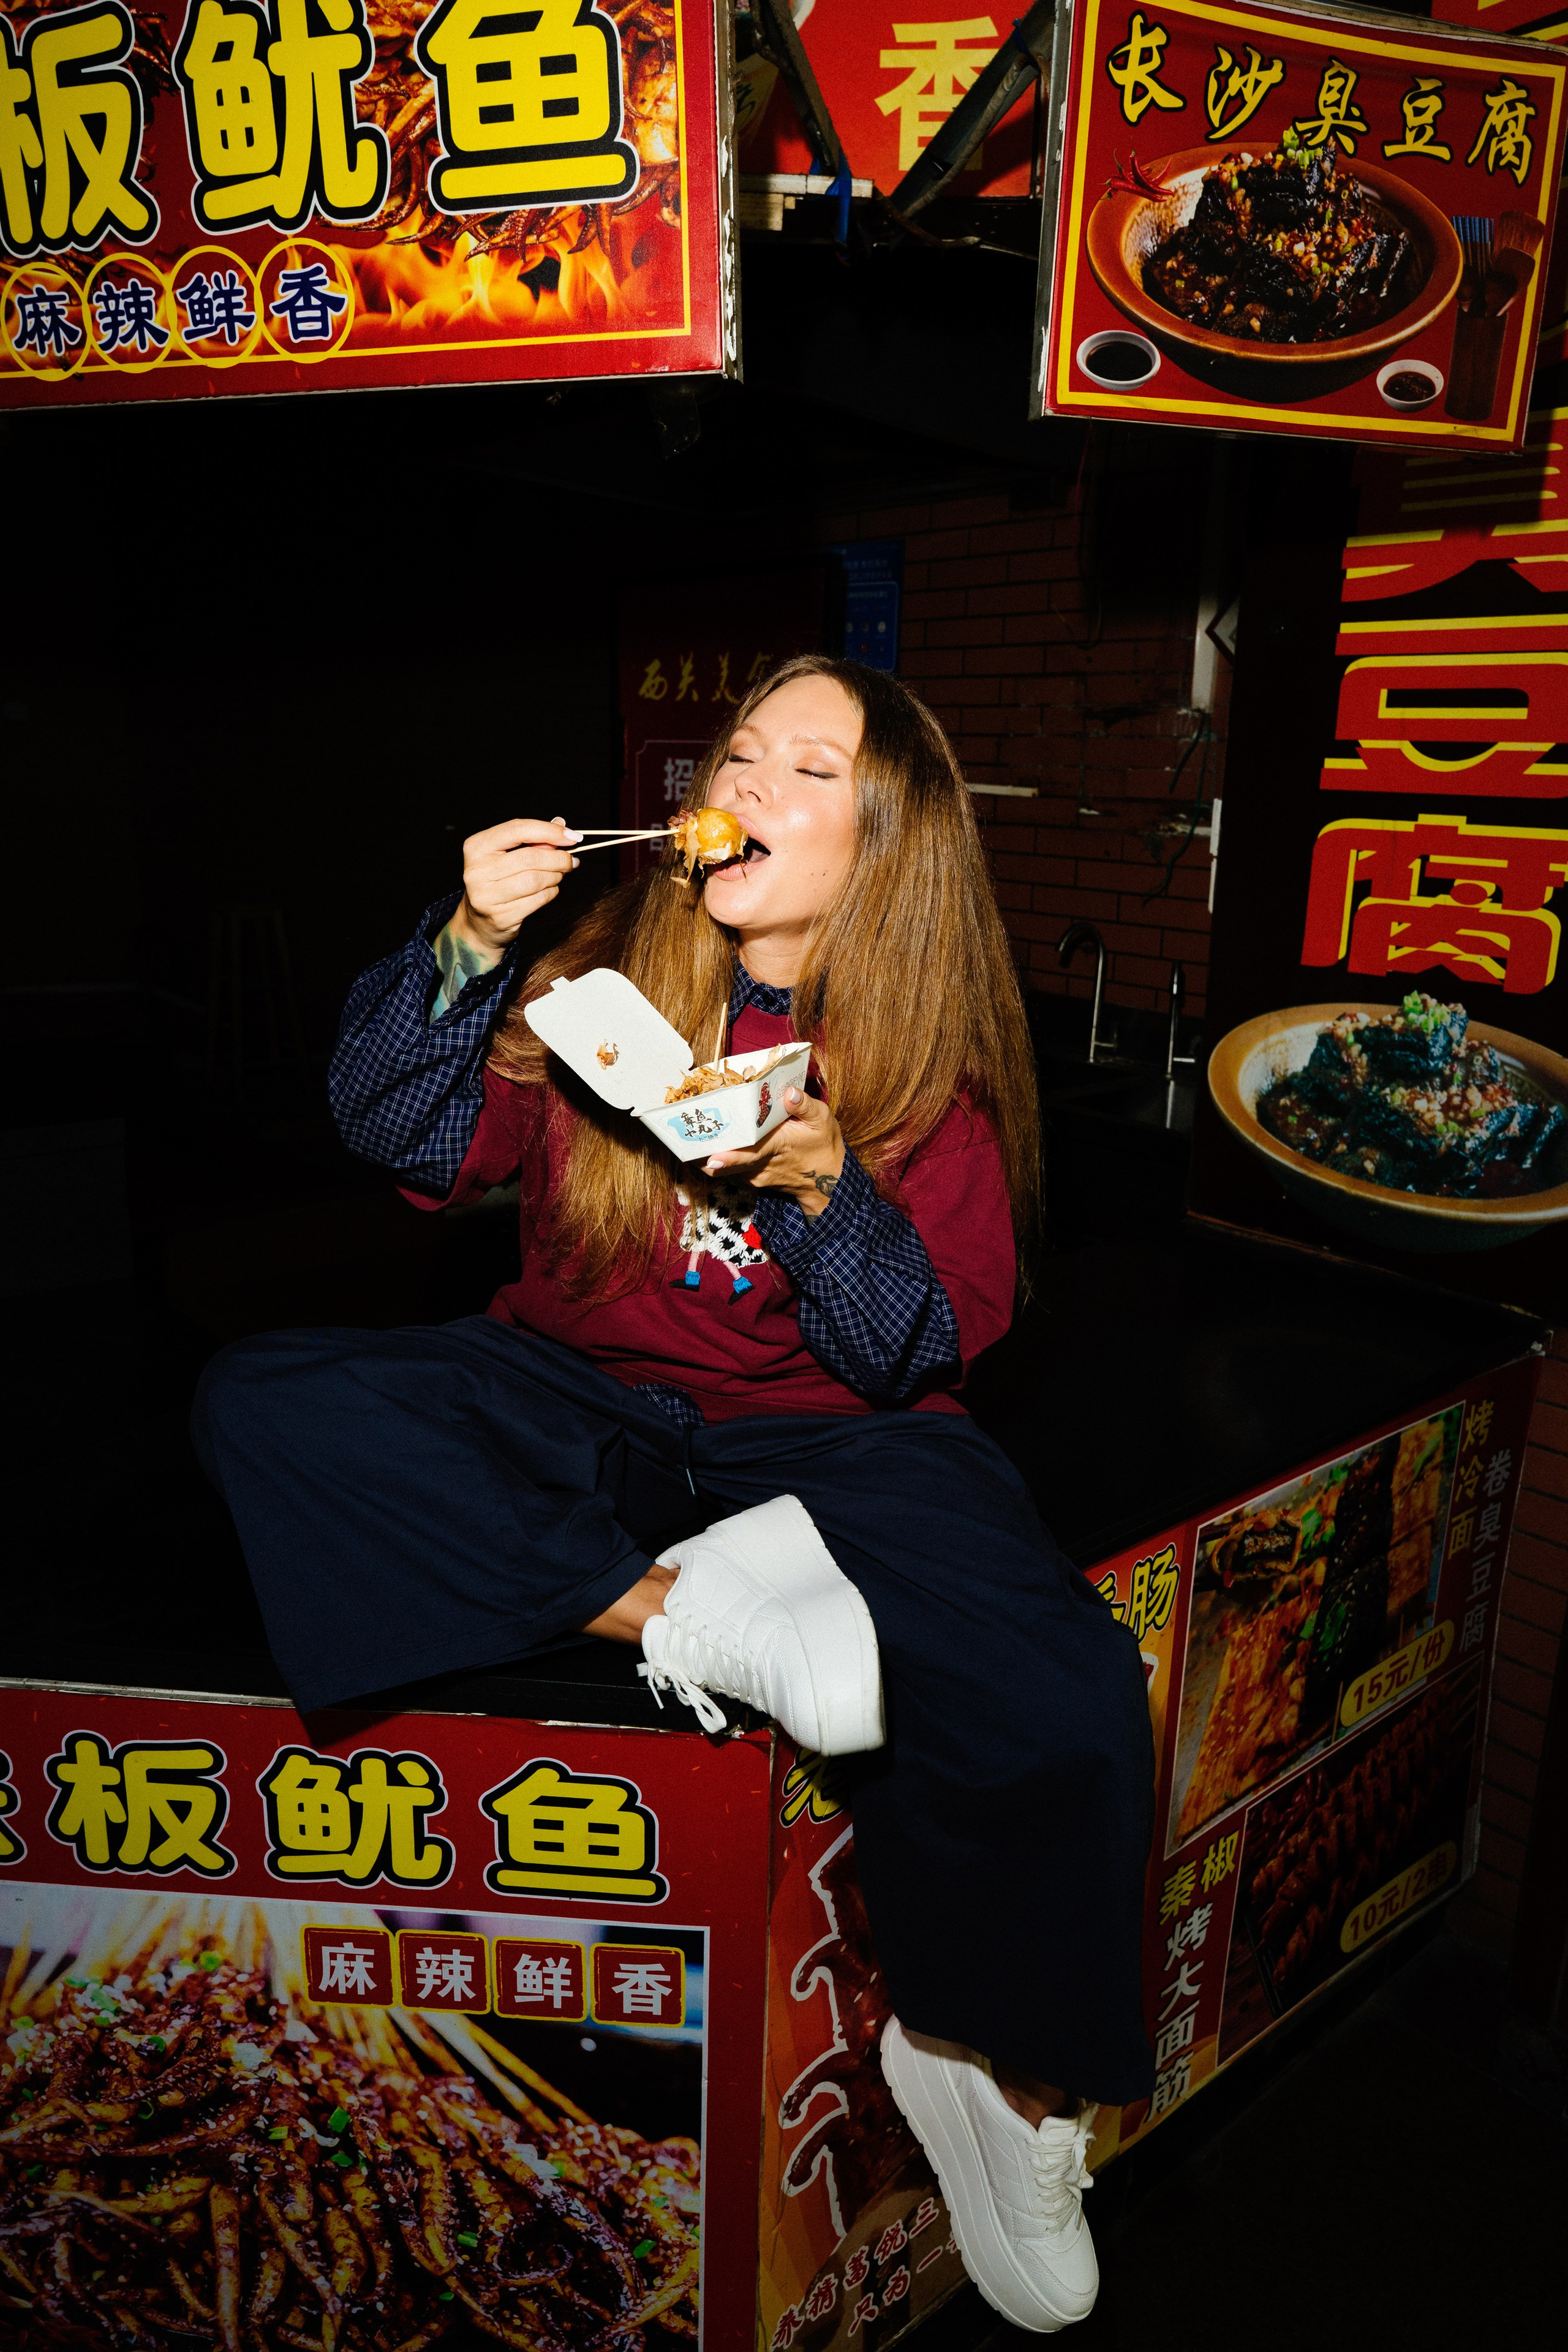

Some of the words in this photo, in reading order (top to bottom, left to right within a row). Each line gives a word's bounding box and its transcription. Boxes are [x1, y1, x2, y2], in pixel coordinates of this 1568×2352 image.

[0, 0, 635, 252] 板鱿鱼
[1107, 13, 1538, 186] 长沙臭豆腐
[13, 262, 346, 356] 麻辣鲜香
[1447, 1399, 1495, 1560] 烤冷面
[1096, 1546, 1178, 1642] 肠
[1458, 1447, 1512, 1653] 卷臭豆腐
[1354, 1629, 1445, 1713] 15元/份
[0, 1731, 669, 1905] 板鱿鱼
[1159, 1830, 1240, 1926] 秦椒
[318, 1940, 673, 2016] 麻辣鲜香
[1144, 1902, 1213, 2124] 烤大面筋
[848, 2231, 960, 2336] 只为一
